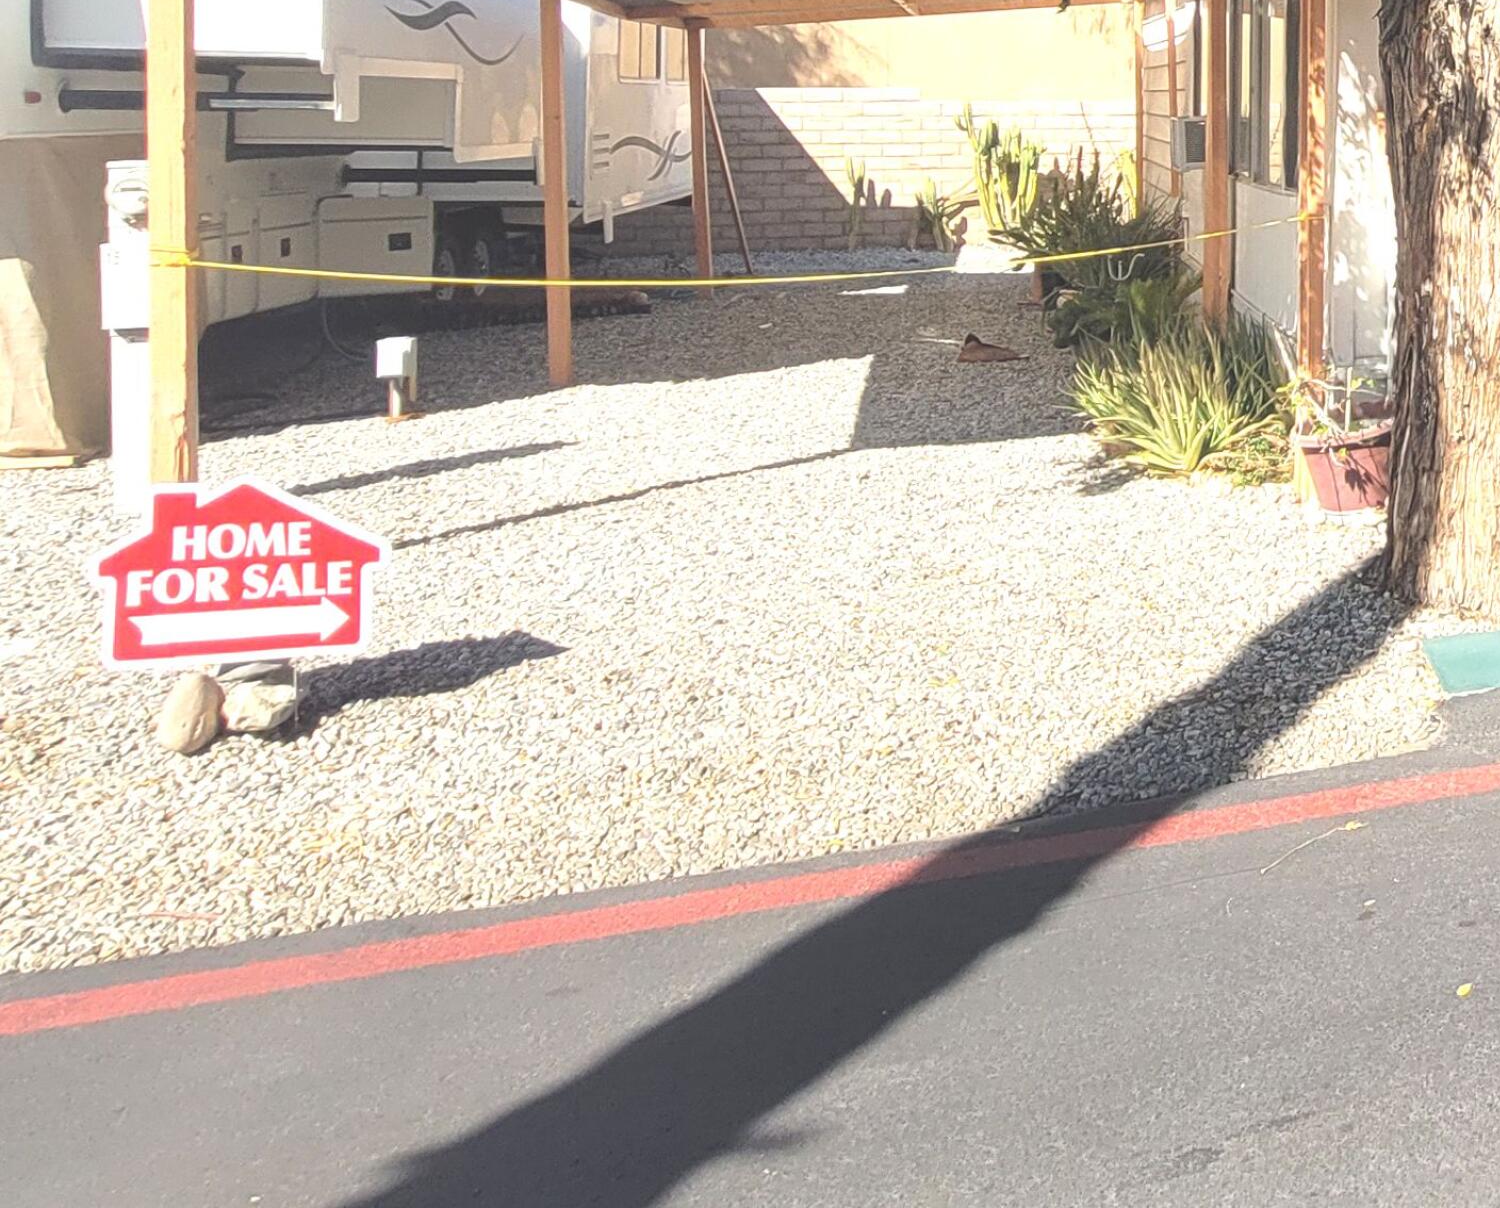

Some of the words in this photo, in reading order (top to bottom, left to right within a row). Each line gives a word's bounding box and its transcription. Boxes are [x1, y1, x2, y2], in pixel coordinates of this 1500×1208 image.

[171, 521, 312, 561] HOME
[124, 566, 230, 607] FOR
[241, 560, 353, 600] SALE
